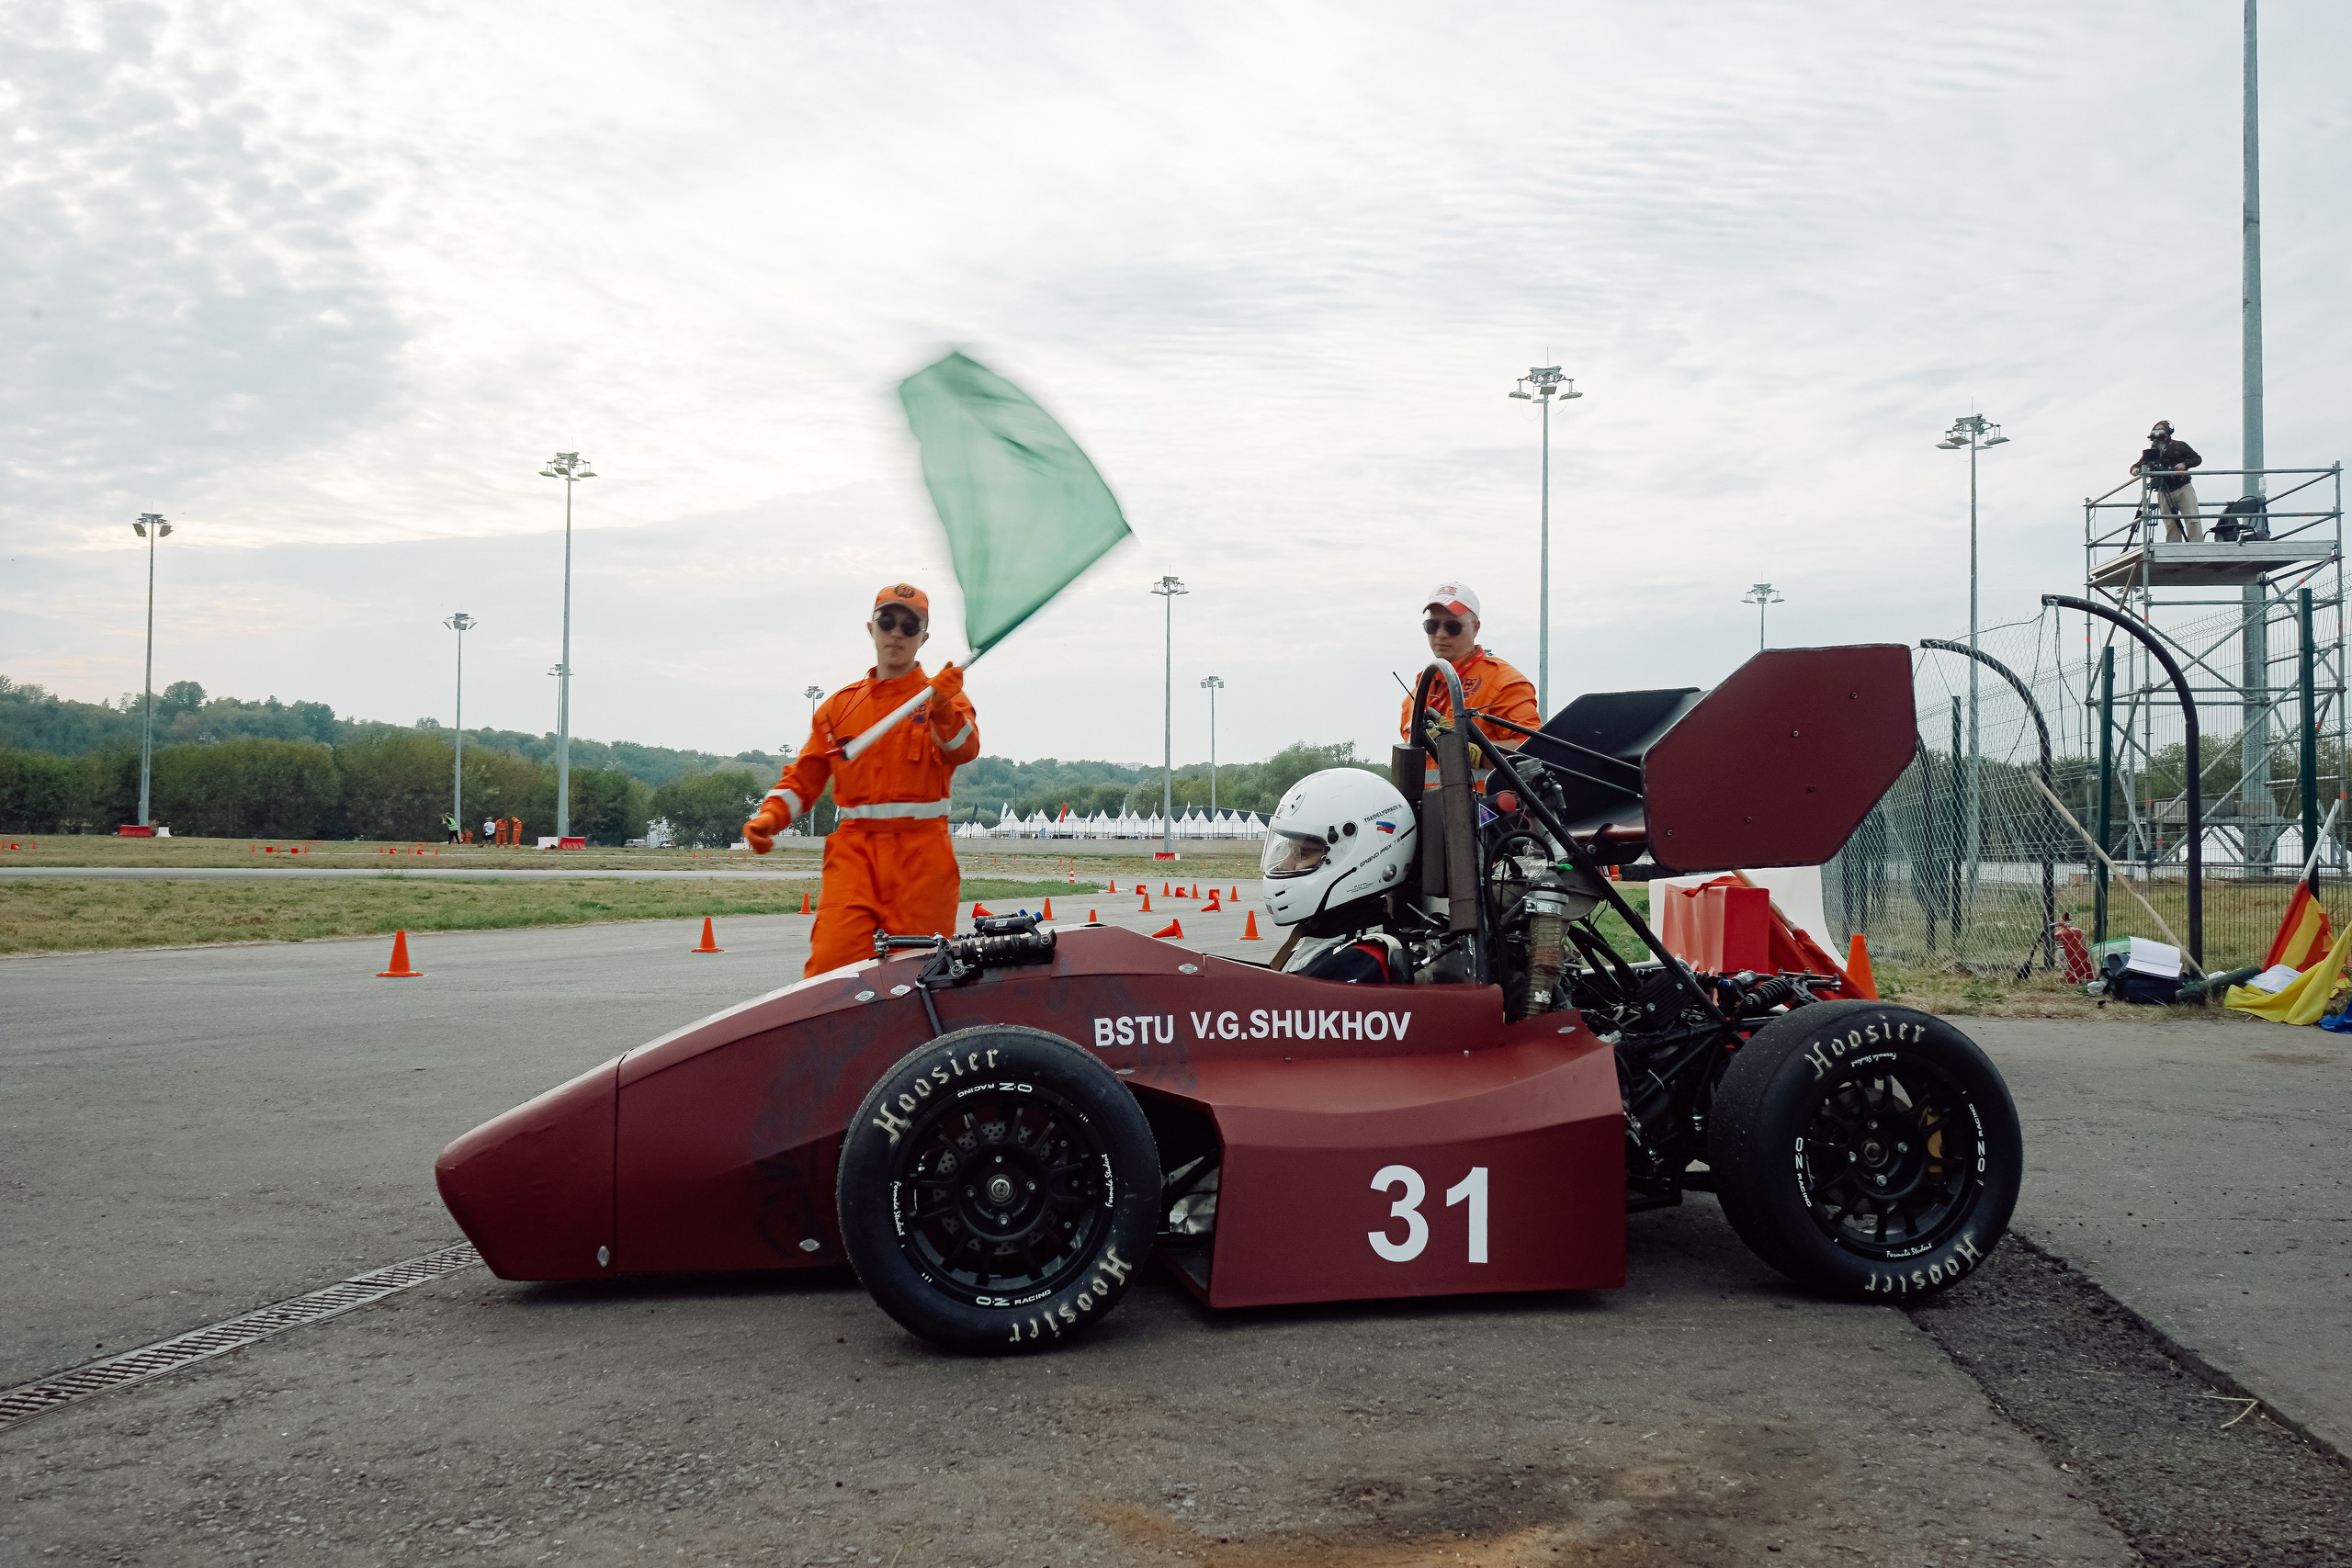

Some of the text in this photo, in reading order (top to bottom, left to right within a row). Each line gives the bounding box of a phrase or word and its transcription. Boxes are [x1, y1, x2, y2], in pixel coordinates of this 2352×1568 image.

[1093, 1009, 1411, 1046] BSTU V.G.SHUKHOV
[1804, 1014, 1927, 1079] Hoosier
[872, 1044, 1000, 1144] Hoosier
[956, 1082, 995, 1098] RACING
[1968, 1103, 1984, 1137] RACING
[1367, 1164, 1488, 1264] 31
[1796, 1172, 1813, 1208] RACING
[1864, 1234, 1984, 1294] Hoosier
[1009, 1246, 1133, 1343] Hoosier
[1014, 1289, 1052, 1305] RACING
